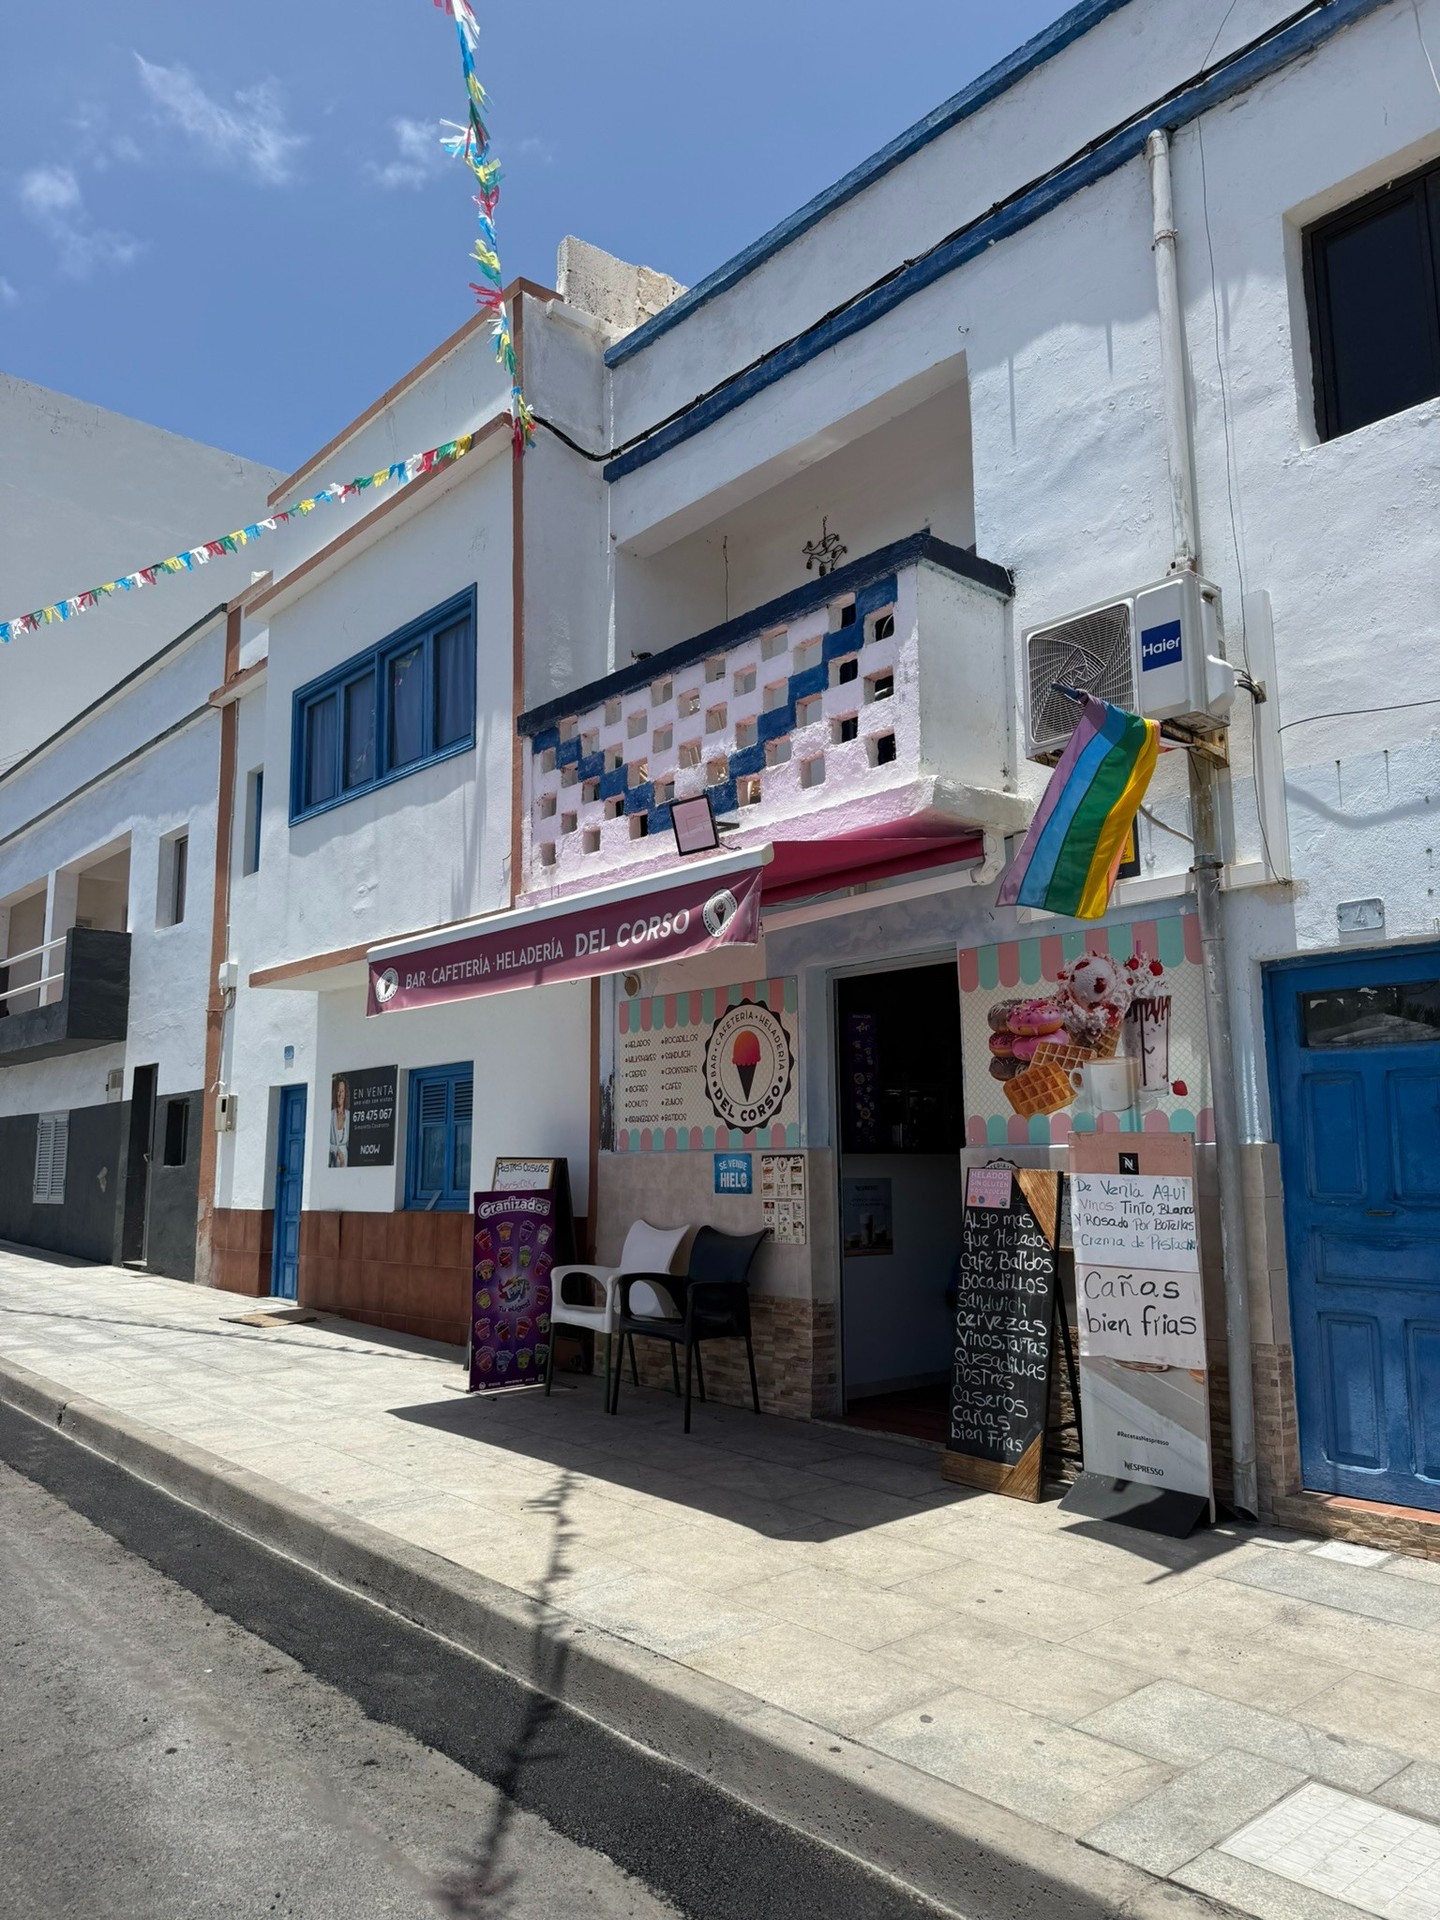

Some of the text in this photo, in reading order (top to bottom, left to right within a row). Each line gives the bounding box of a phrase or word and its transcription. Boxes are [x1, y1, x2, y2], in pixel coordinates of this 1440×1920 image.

[1142, 636, 1180, 658] Haier
[405, 972, 426, 990] BAR
[431, 954, 490, 984] CAFETERÍA
[496, 937, 564, 971] HELADERÍA
[575, 929, 611, 957] DEL
[616, 908, 690, 948] CORSO
[353, 1085, 393, 1100] EN VENTA
[714, 1085, 780, 1122] DEL CORSO
[353, 1108, 393, 1122] 678 475 067
[719, 1159, 748, 1171] SE VENDE
[720, 1172, 747, 1188] HIELO
[971, 1170, 1010, 1180] HELADOS
[982, 1180, 1009, 1188] GLUTEN
[479, 1196, 550, 1218] Granizados
[1080, 1198, 1114, 1212] Vinos
[1003, 1213, 1034, 1229] mas
[1081, 1233, 1126, 1248] Crema
[1131, 1235, 1145, 1248] de
[1084, 1271, 1180, 1300] Cañas
[956, 1310, 1048, 1337] Cervezas
[1085, 1304, 1197, 1336] bien frias
[952, 1384, 1028, 1418] Caseros
[950, 1421, 983, 1444] bien
[1123, 1460, 1164, 1476] NESPRESSO
